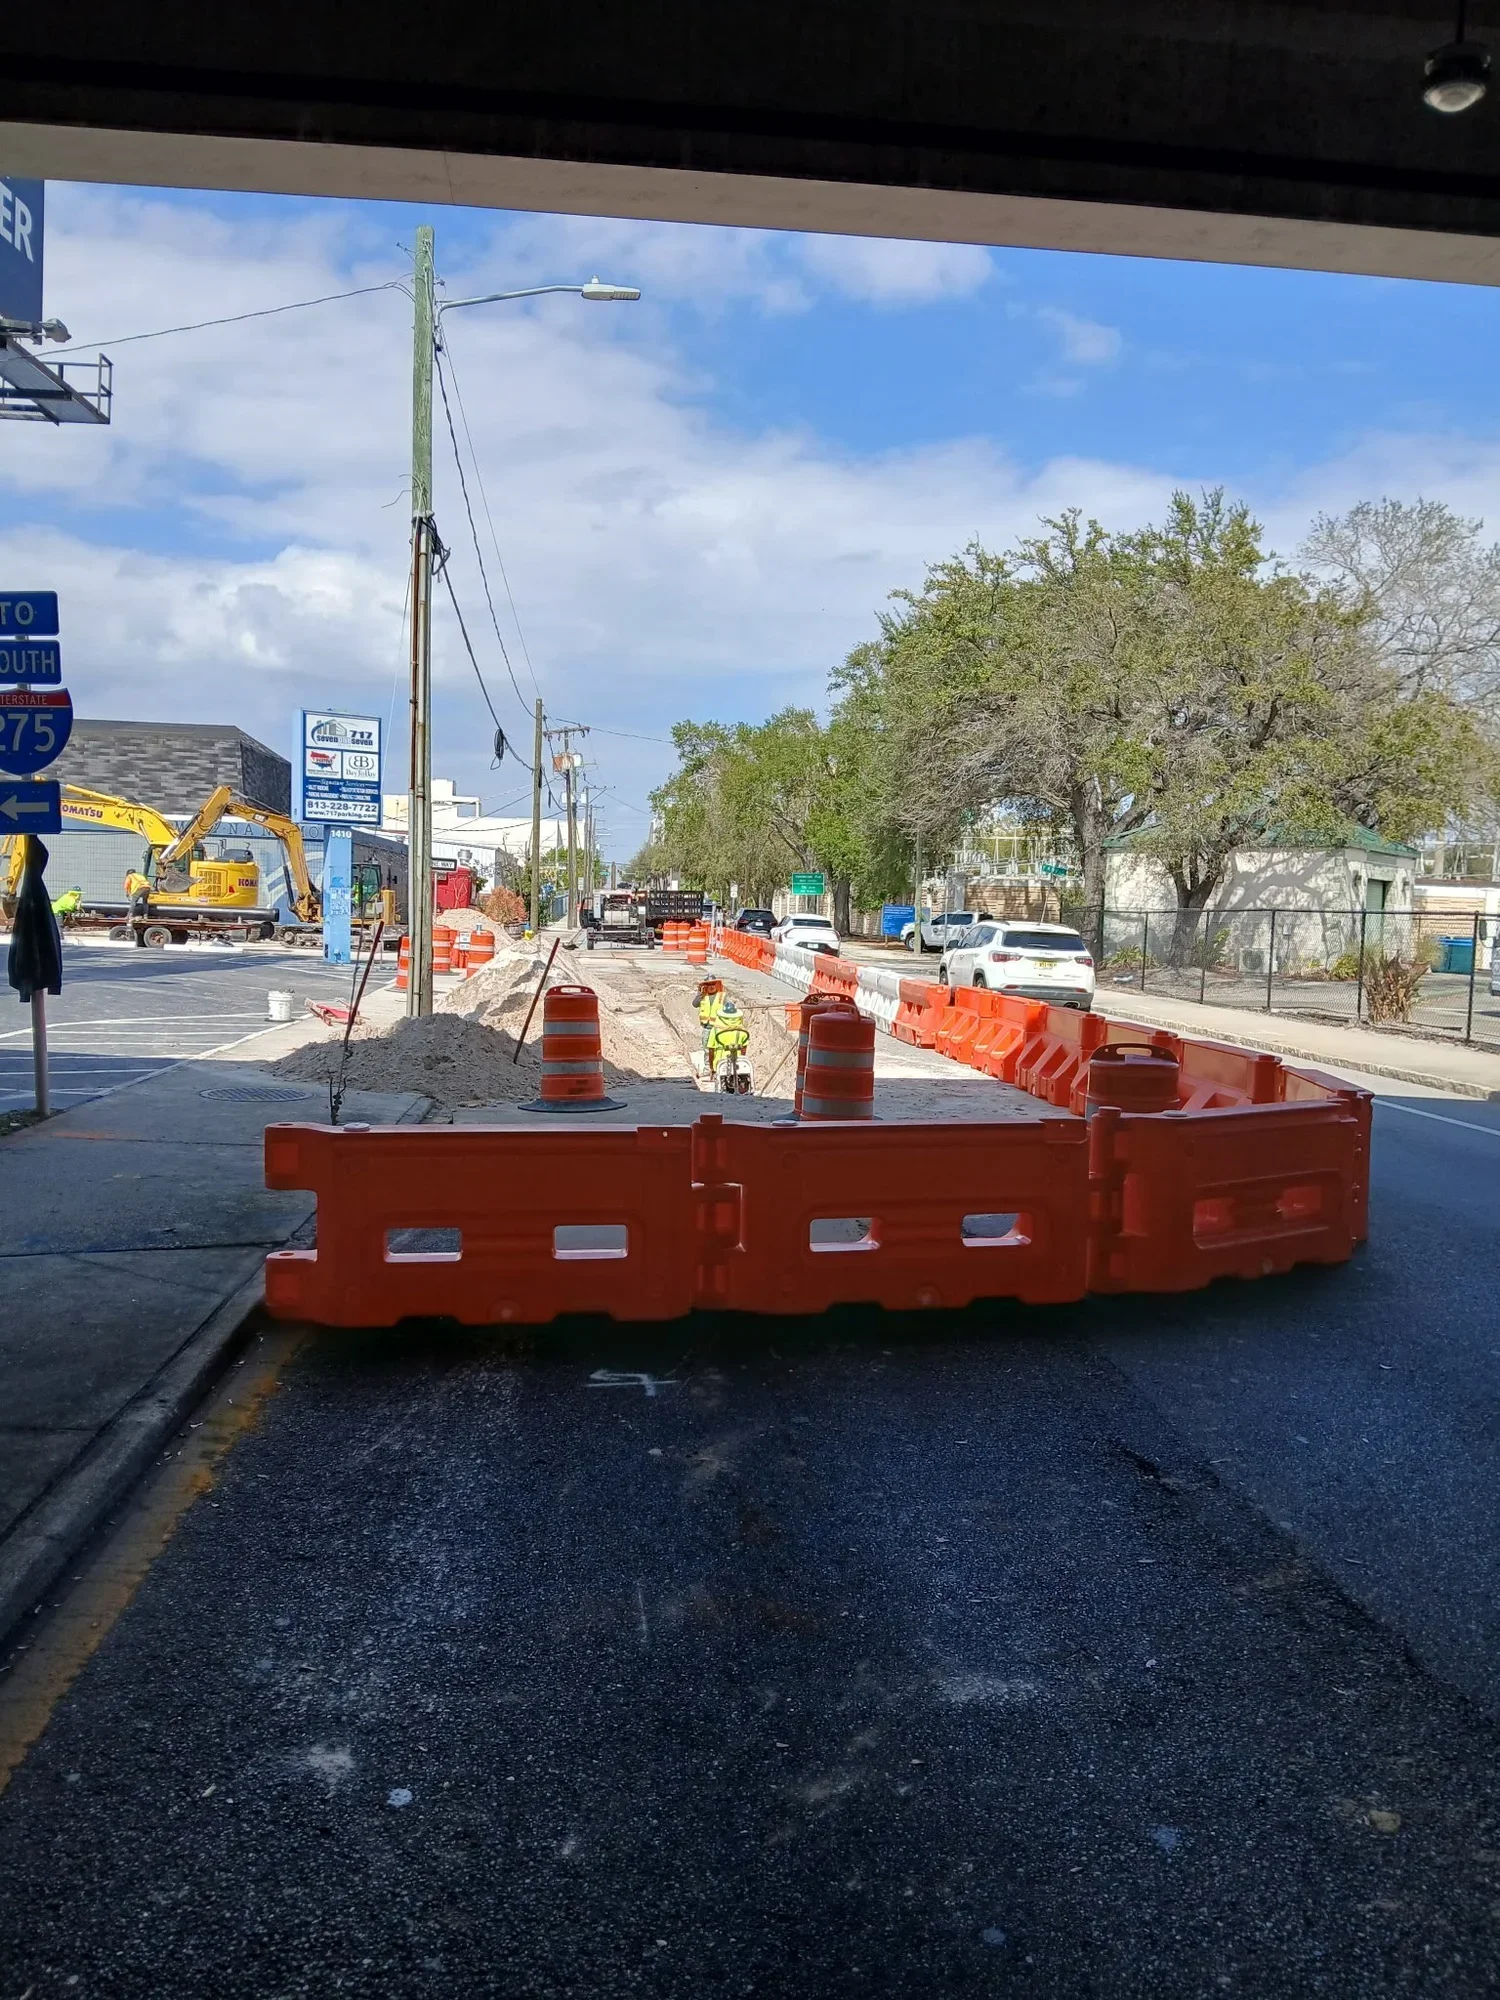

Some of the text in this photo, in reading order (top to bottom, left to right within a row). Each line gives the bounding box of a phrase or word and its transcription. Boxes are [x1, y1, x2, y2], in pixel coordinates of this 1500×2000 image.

[0, 181, 34, 263] ER
[0, 601, 34, 625] TO
[349, 729, 373, 739] 717
[307, 800, 377, 813] 813-228-7722
[307, 810, 377, 819] www.717parking.com
[330, 829, 352, 838] 1410
